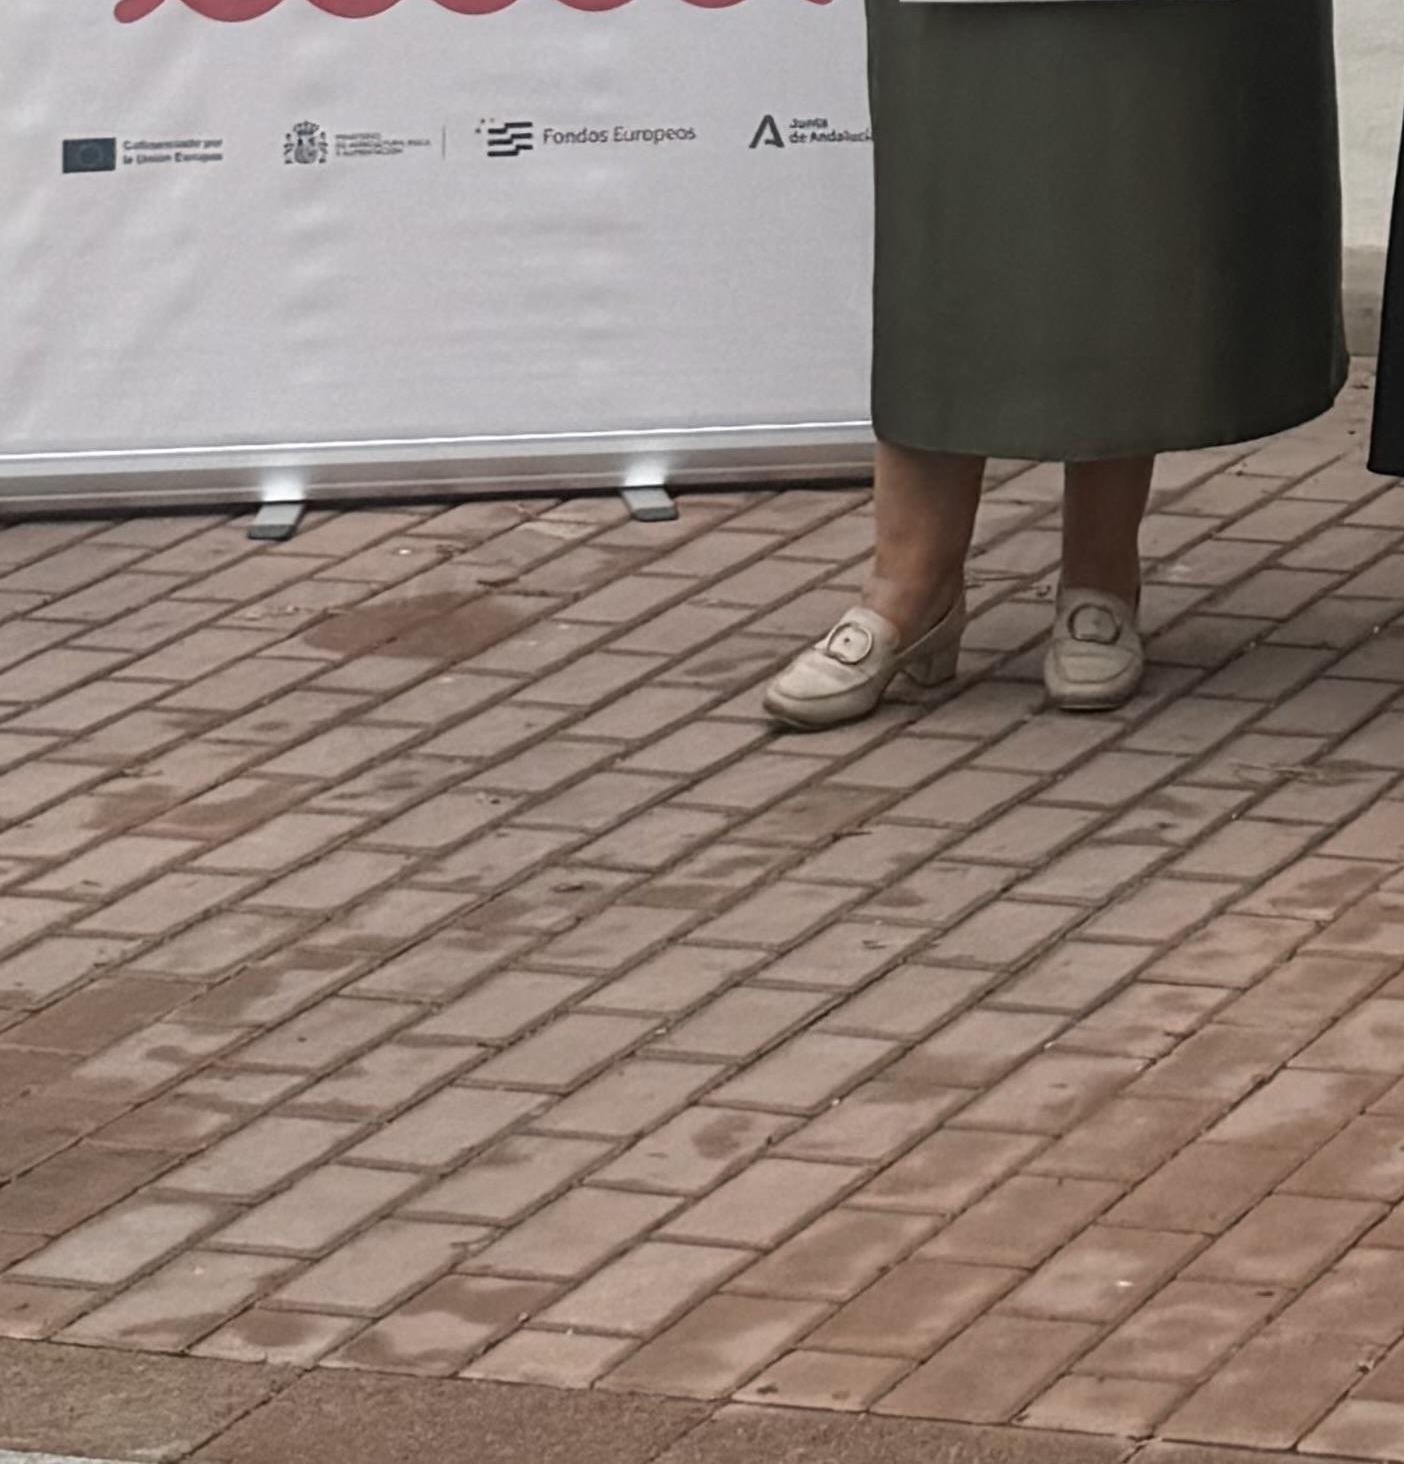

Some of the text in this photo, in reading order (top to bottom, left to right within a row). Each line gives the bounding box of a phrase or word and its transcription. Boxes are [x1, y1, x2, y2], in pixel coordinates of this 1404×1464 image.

[789, 118, 828, 129] Junta
[543, 126, 696, 145] Fondos Europeos
[789, 133, 806, 143] de
